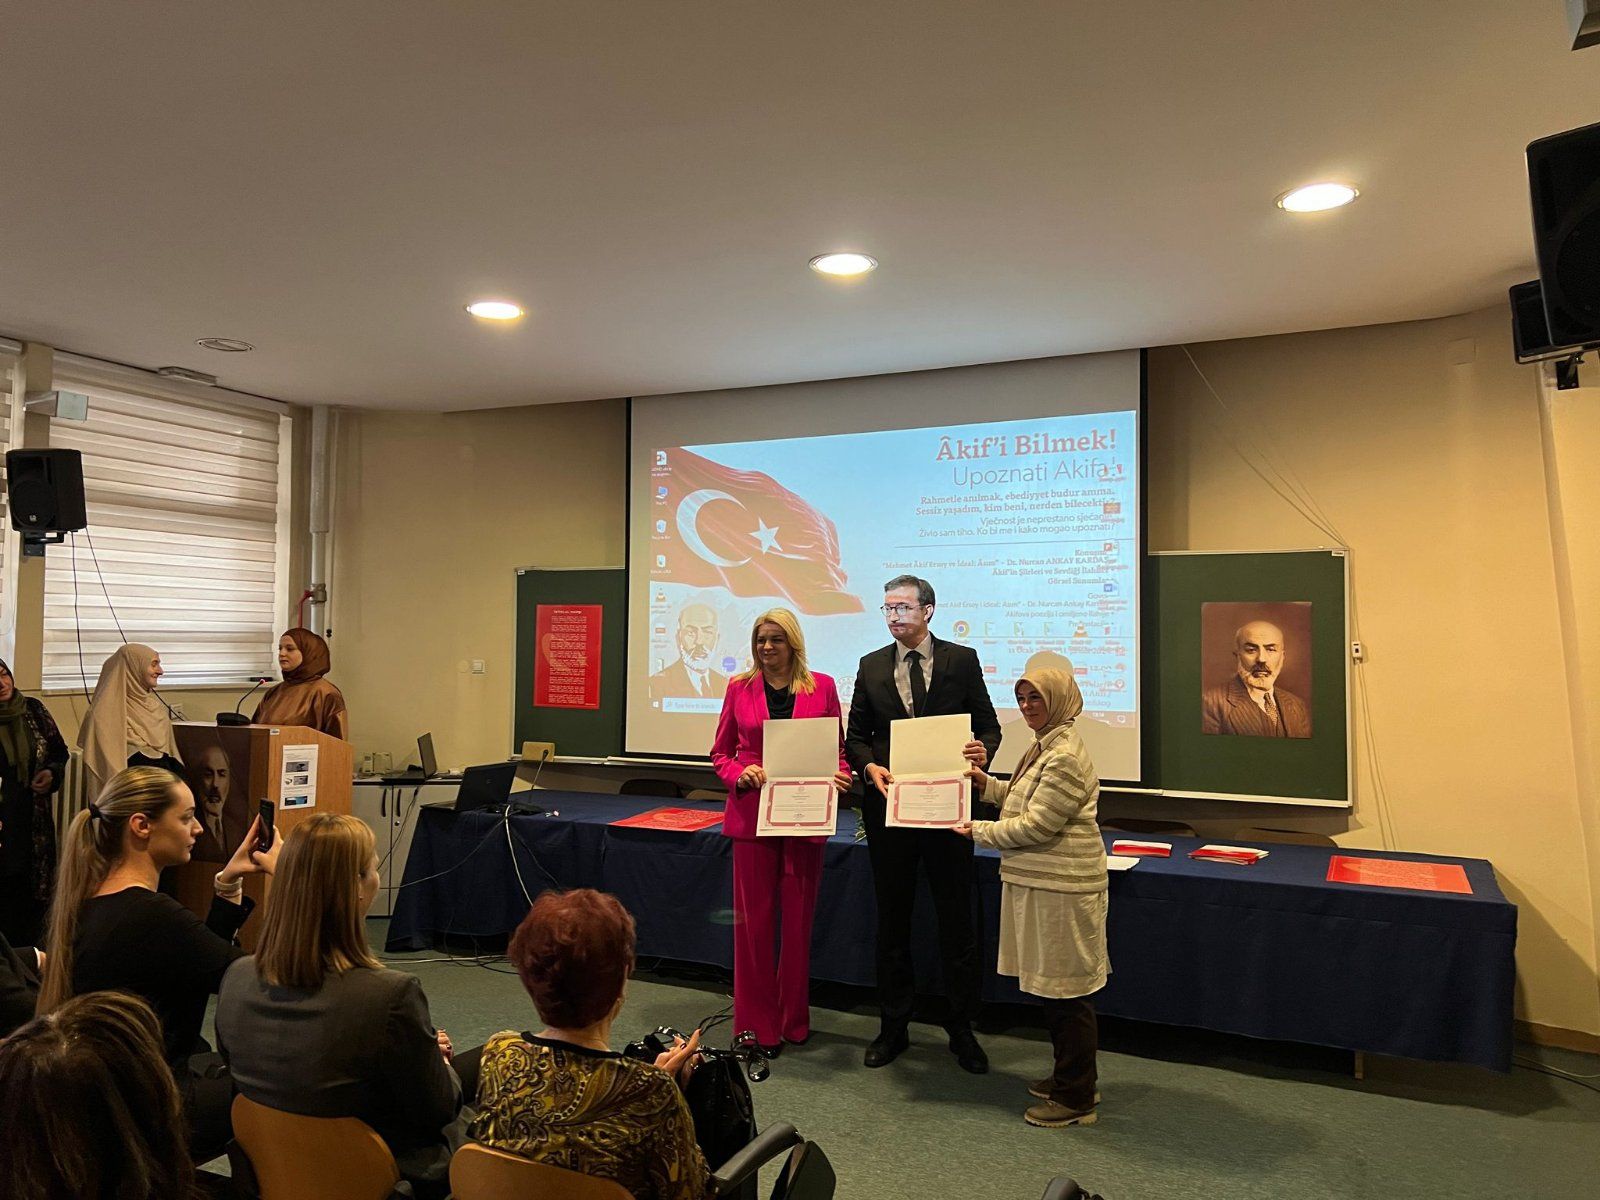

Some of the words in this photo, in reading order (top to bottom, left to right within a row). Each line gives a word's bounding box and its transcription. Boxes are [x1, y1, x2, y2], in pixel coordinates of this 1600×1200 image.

[1014, 429, 1117, 456] Bilmek!
[953, 462, 1048, 490] Upoznati
[920, 495, 962, 504] Rahmetle
[1005, 490, 1049, 500] ebediyyet
[1051, 488, 1079, 498] budur
[915, 507, 942, 515] Sessiz
[984, 503, 1002, 512] kim
[1004, 502, 1027, 512] beni,
[1029, 501, 1063, 510] nerden
[980, 516, 1015, 527] Vječnost
[1016, 517, 1025, 526] je
[1027, 514, 1074, 524] neprestano
[977, 528, 988, 536] Ko
[989, 526, 998, 535] bi
[1018, 526, 1039, 534] kako
[1040, 525, 1070, 534] mogao
[1072, 523, 1115, 533] upoznati?
